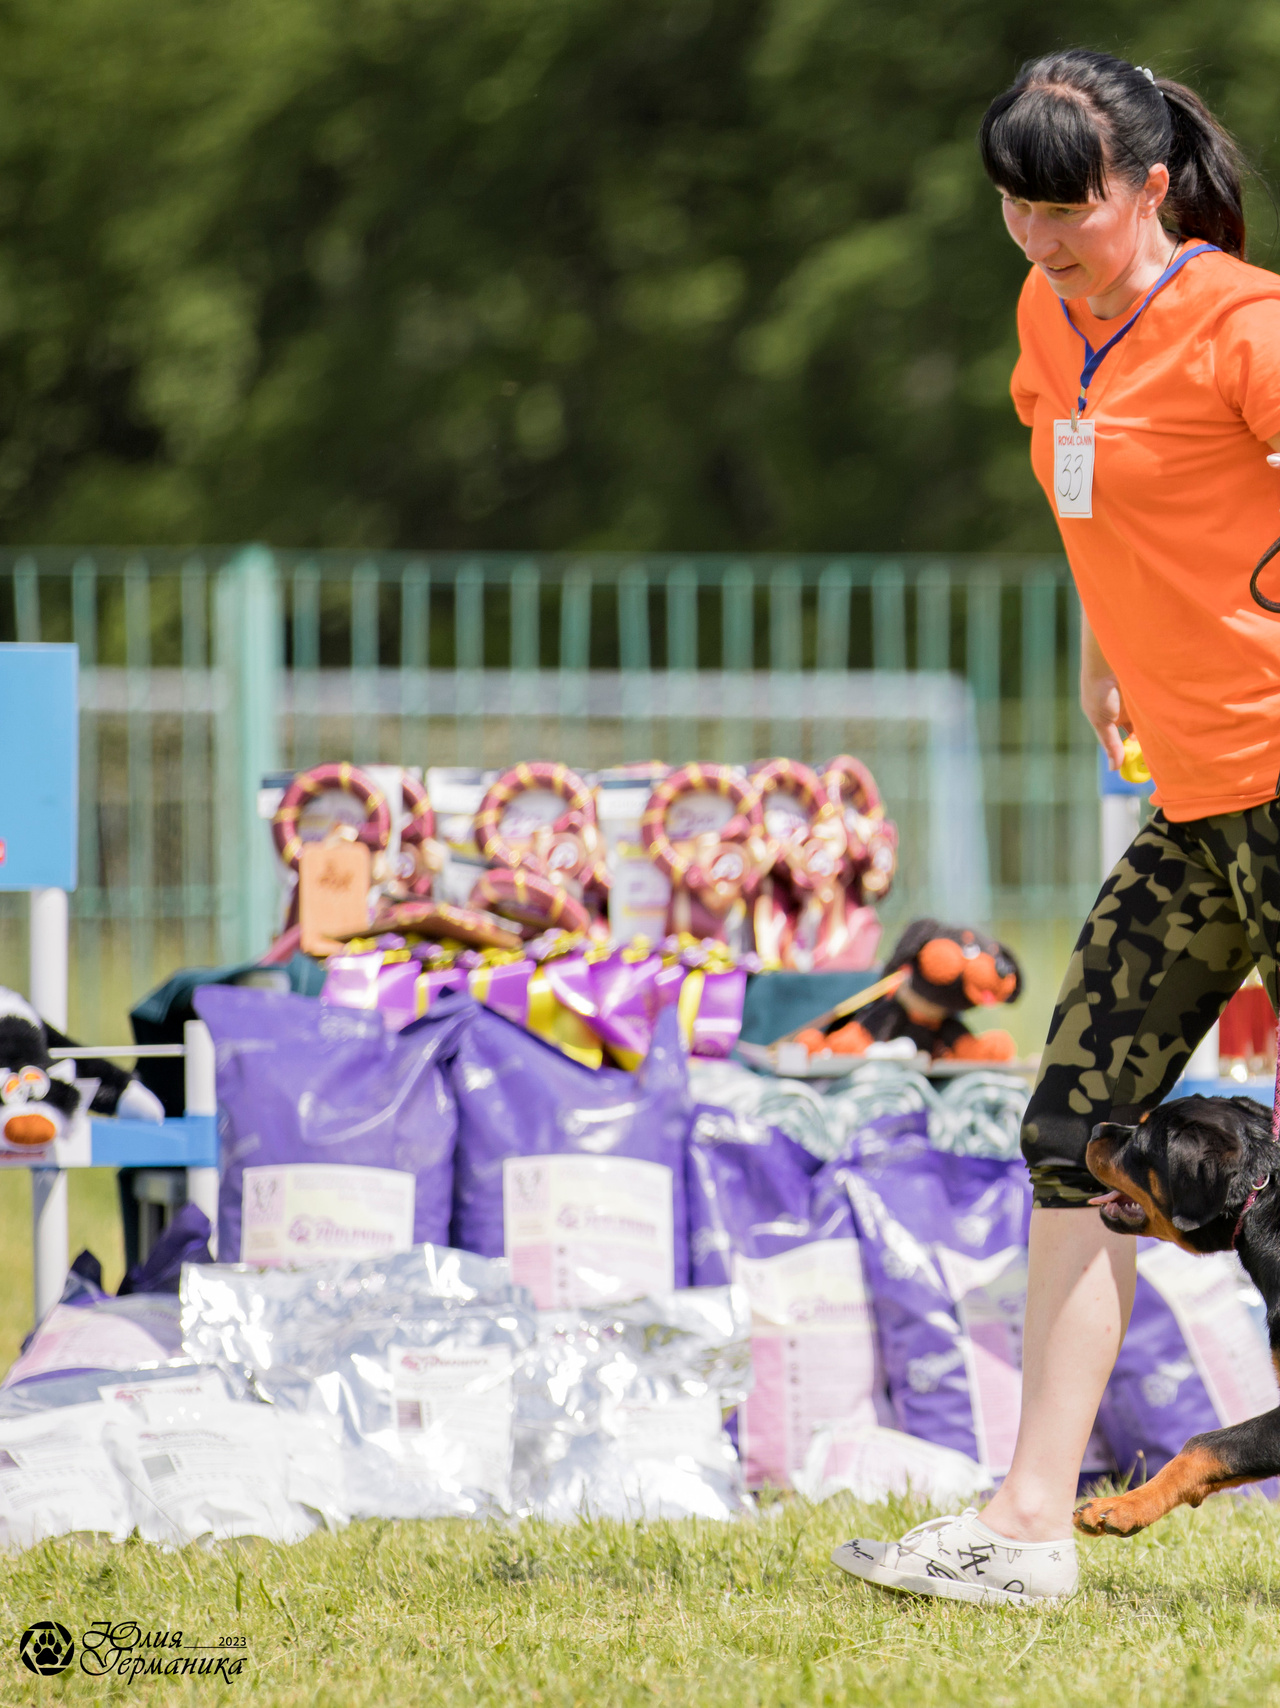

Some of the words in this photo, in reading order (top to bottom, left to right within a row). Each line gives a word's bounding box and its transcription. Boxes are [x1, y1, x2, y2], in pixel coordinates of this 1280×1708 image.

[1057, 435, 1075, 446] ROYAL
[1076, 435, 1092, 446] CANIN
[1057, 453, 1084, 501] 33
